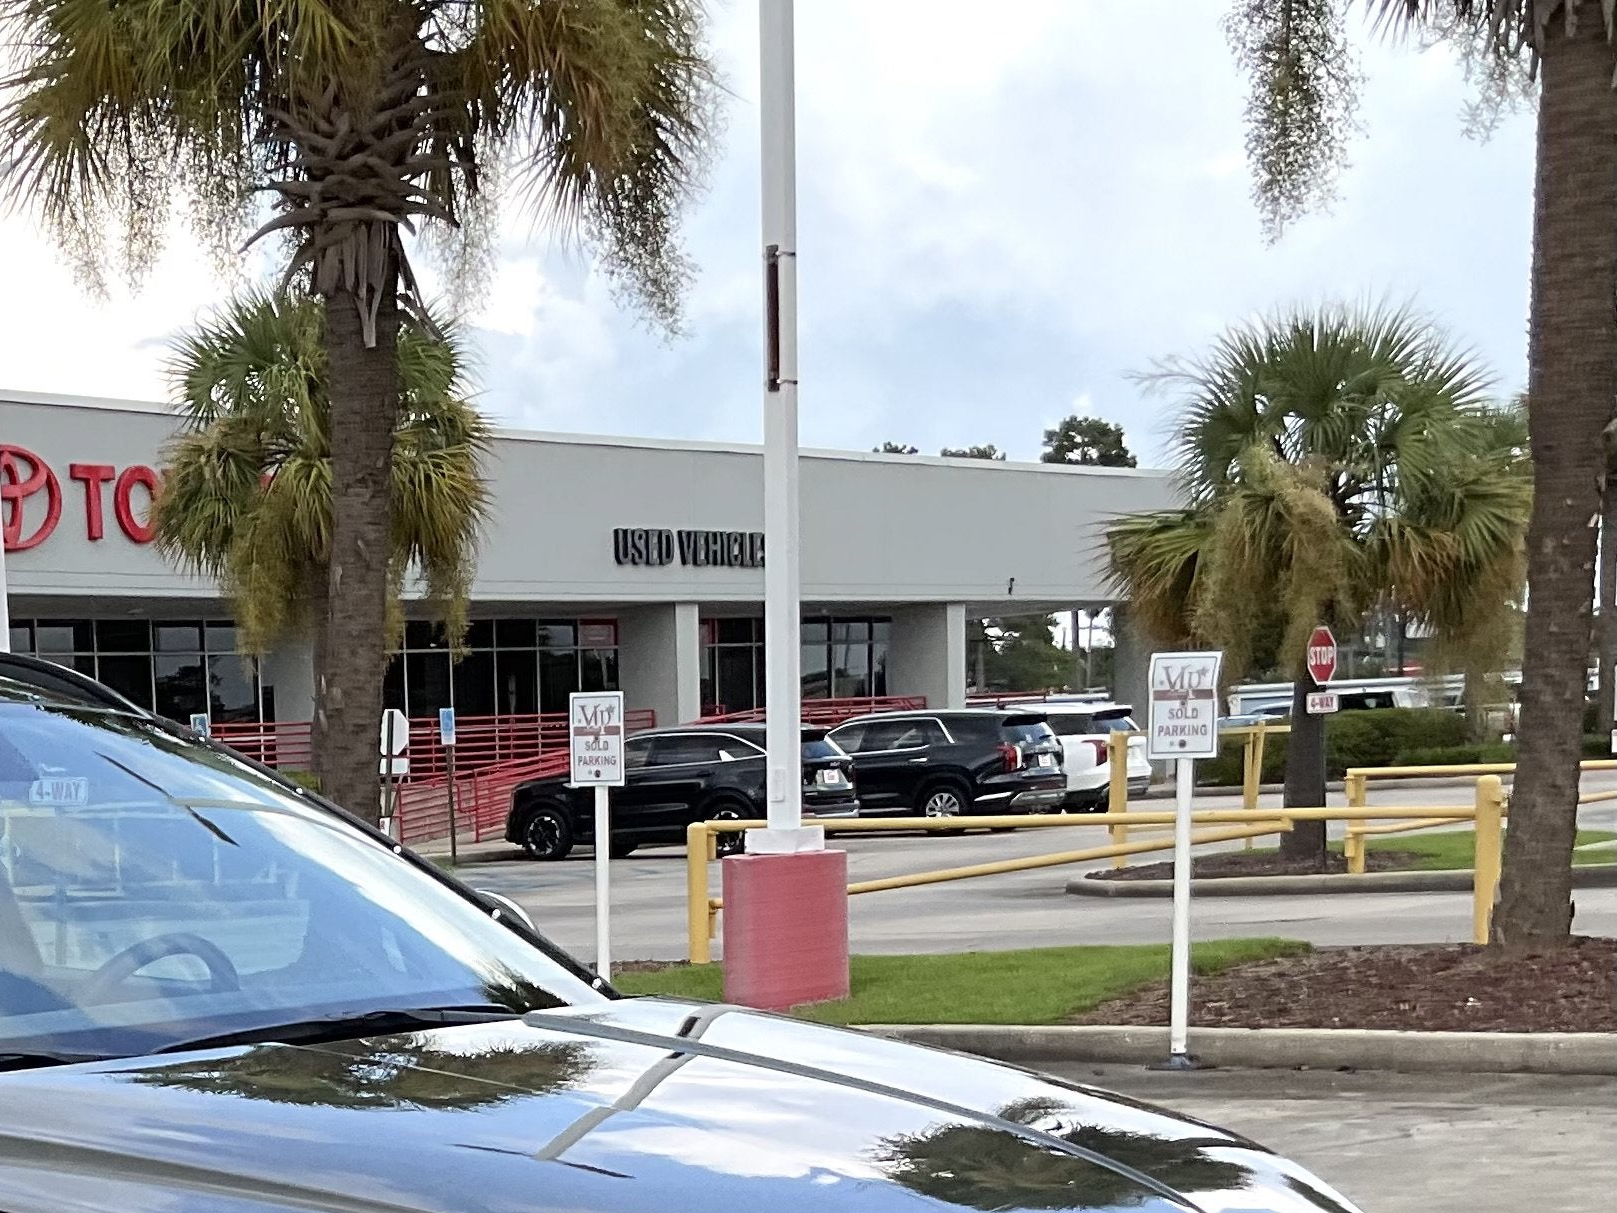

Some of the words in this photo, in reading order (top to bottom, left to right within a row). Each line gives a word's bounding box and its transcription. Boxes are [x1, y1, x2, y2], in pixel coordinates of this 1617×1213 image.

[613, 528, 674, 566] USED
[677, 529, 765, 568] VEHICLE
[1310, 646, 1334, 666] STOP
[1167, 707, 1199, 720] SOLD
[1157, 724, 1208, 737] PARKING
[585, 740, 609, 752] SOLD
[577, 755, 617, 767] PARKING
